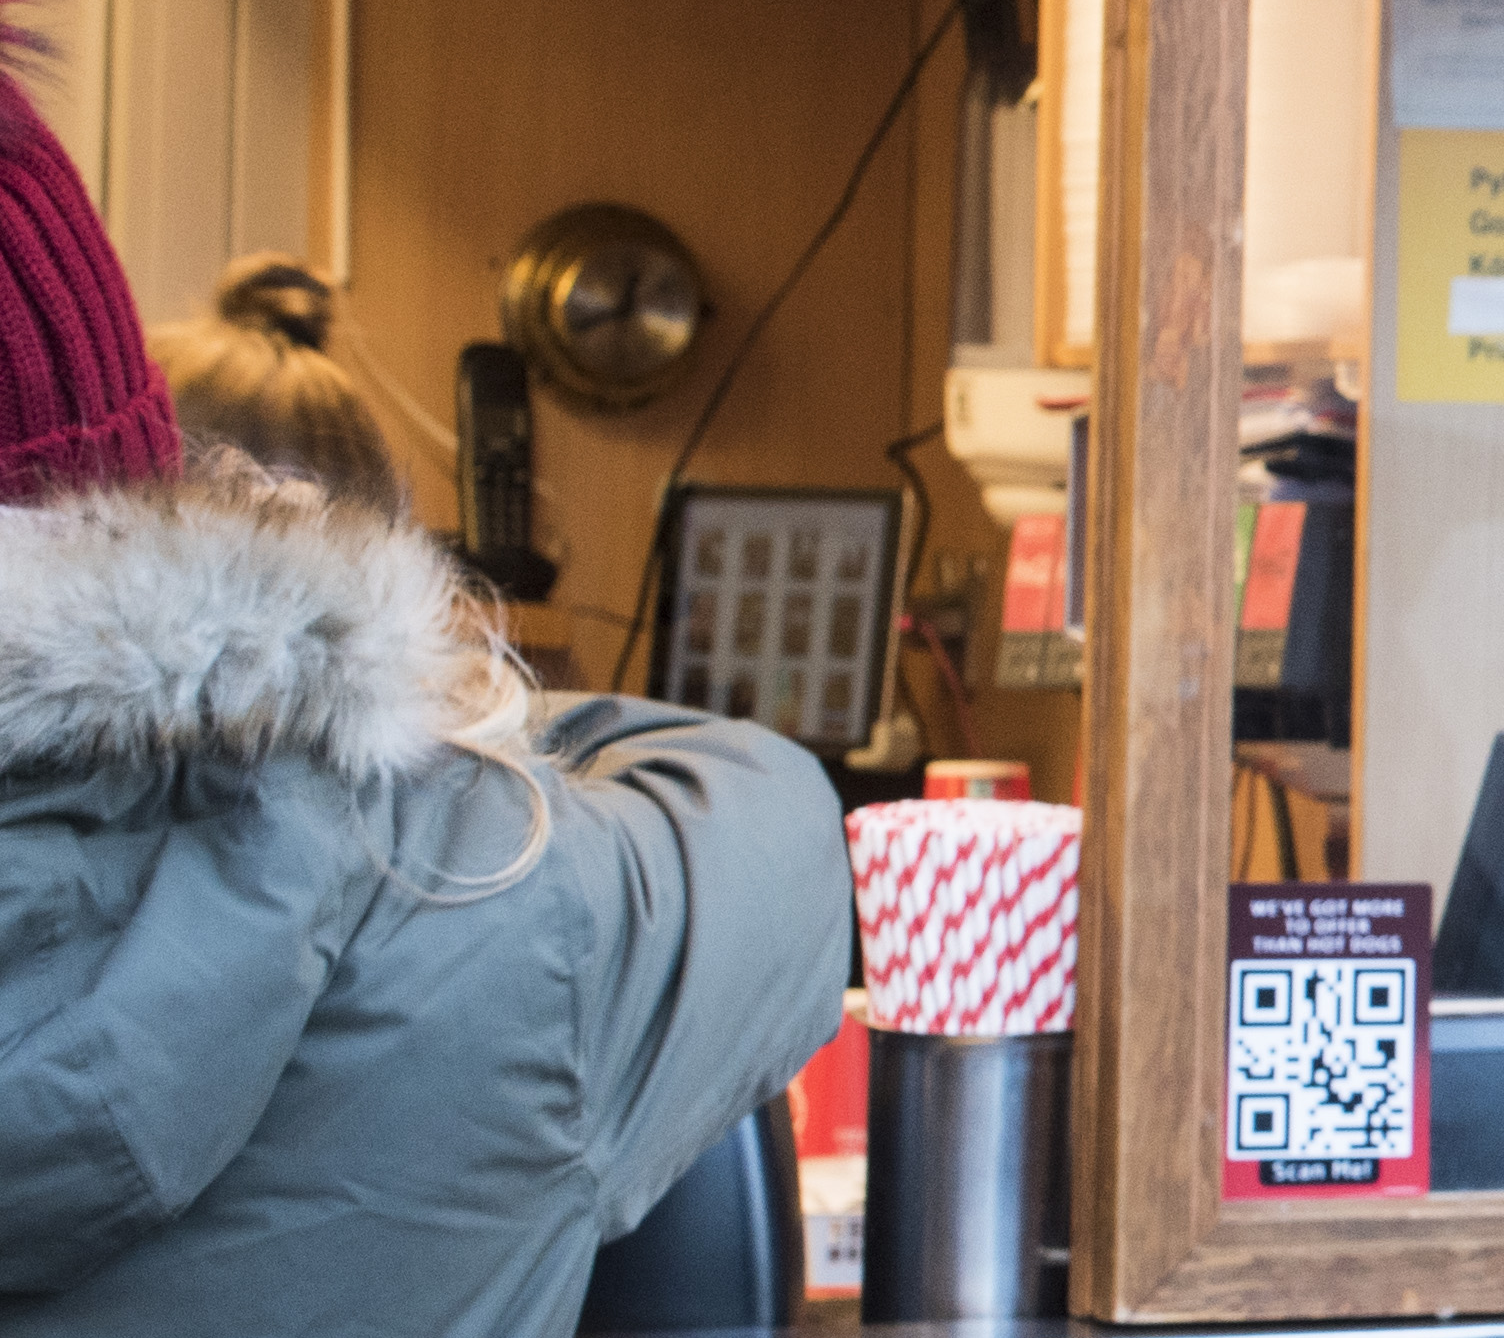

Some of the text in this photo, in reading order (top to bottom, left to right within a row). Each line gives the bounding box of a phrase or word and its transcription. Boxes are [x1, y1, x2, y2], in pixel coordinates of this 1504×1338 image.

[1309, 898, 1348, 918] GOT
[1352, 898, 1405, 918] MORE
[1285, 916, 1311, 936] TO
[1271, 1160, 1327, 1182] Scan
